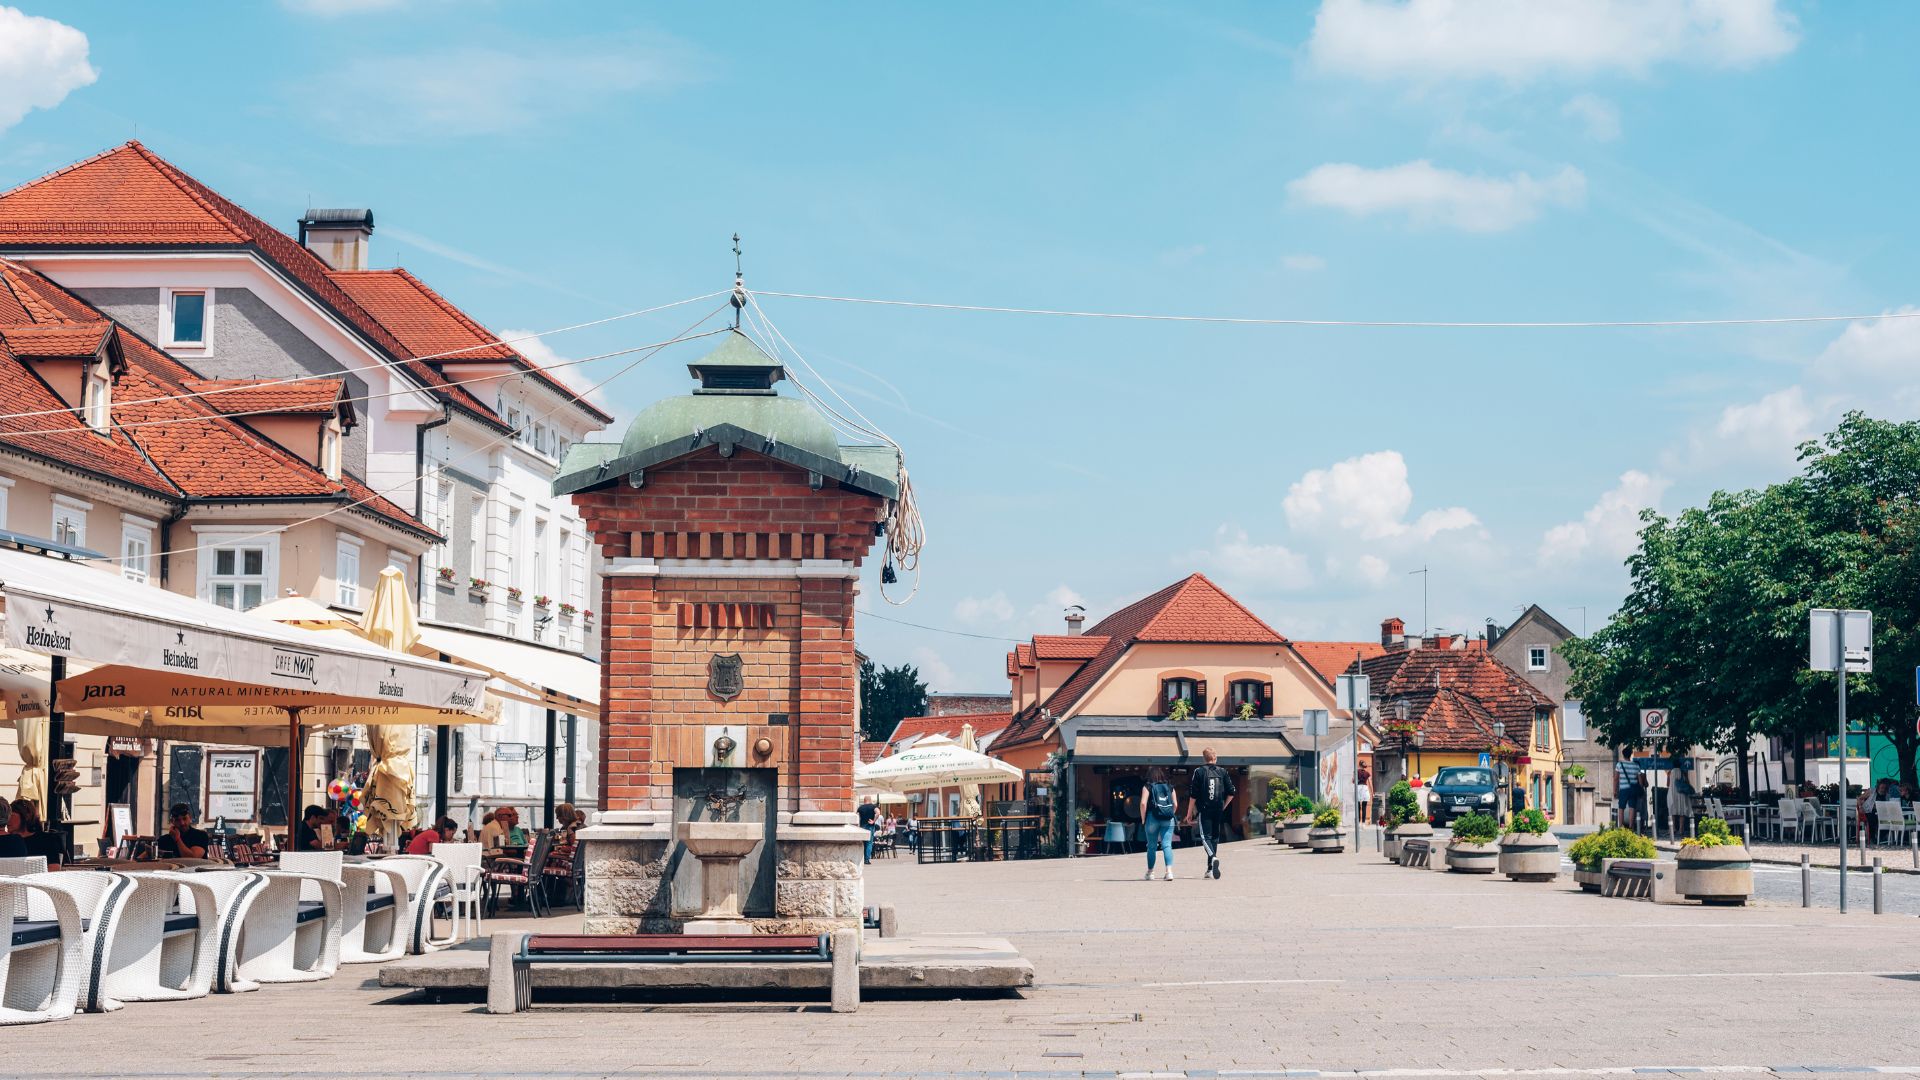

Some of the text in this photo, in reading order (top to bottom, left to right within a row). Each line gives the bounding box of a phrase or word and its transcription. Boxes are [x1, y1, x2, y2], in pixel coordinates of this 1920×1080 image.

[26, 626, 71, 651] Heineken
[163, 649, 199, 670] Heineken
[275, 655, 291, 672] CAFE
[171, 687, 233, 696] NATURAL
[237, 687, 297, 696] MINERAL
[378, 681, 404, 697] Heineken
[1650, 716, 1660, 724] 30
